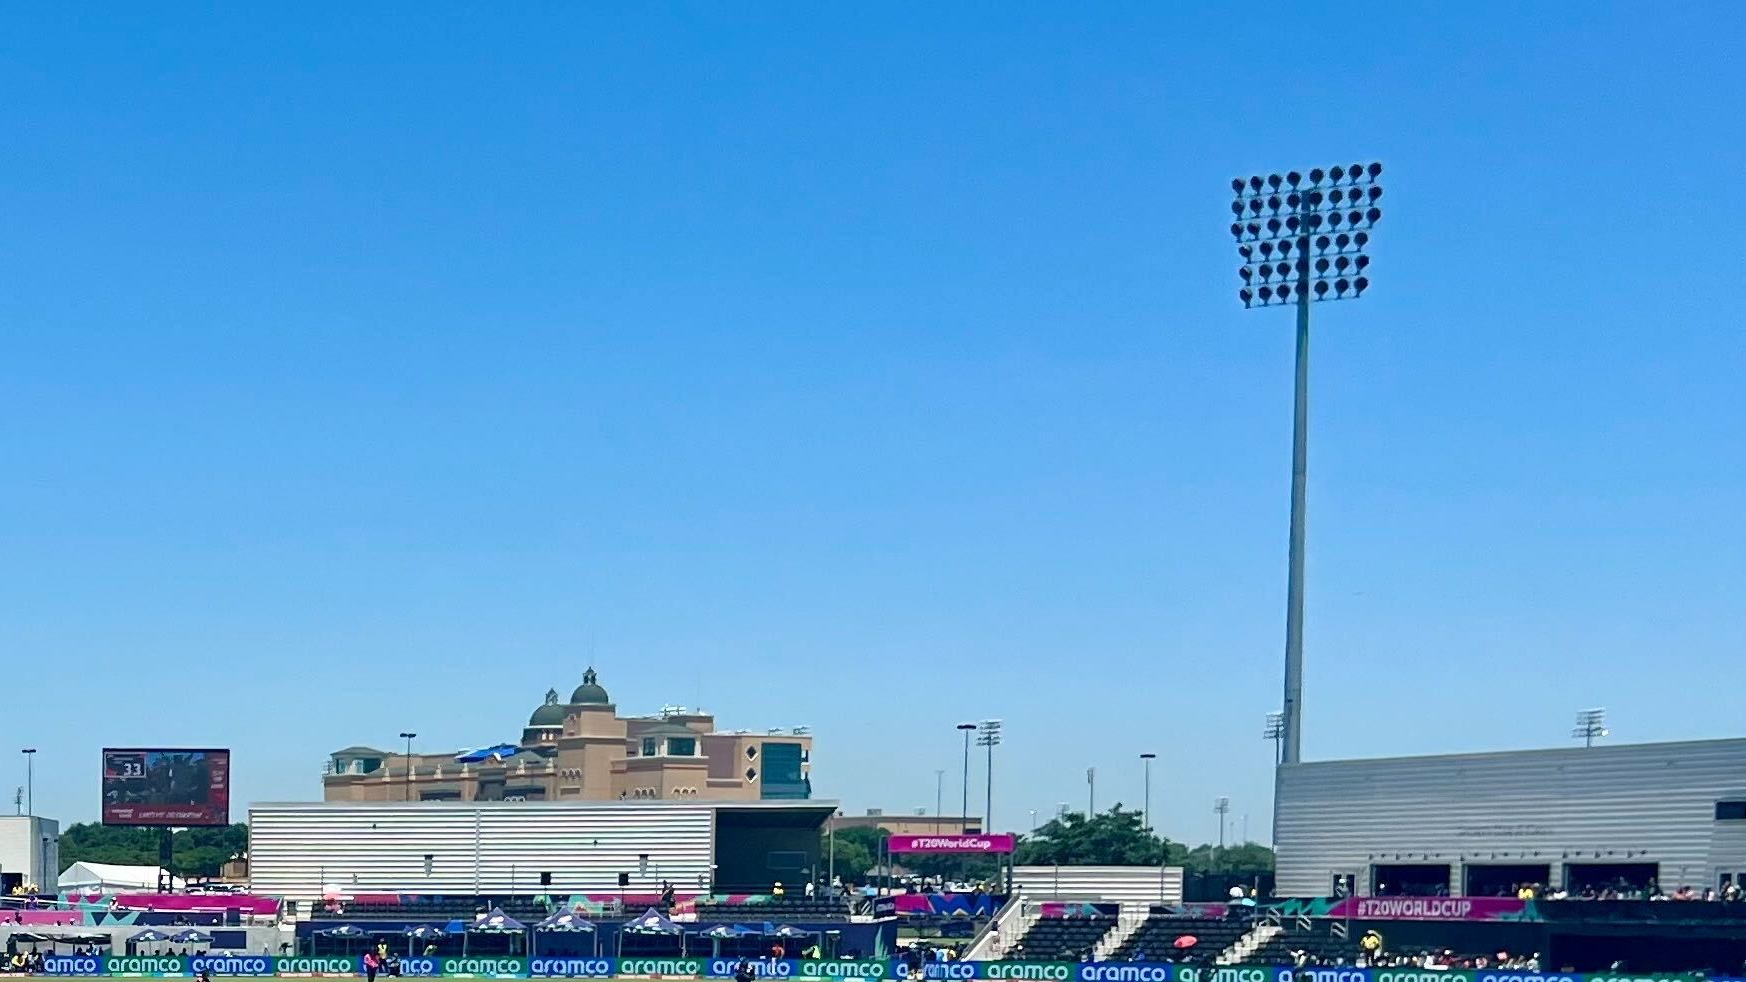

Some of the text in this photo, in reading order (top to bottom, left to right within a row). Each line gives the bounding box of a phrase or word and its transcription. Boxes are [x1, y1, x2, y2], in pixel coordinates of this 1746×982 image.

[124, 763, 142, 776] 33
[911, 839, 991, 851] #T20WorldCup
[1358, 901, 1471, 916] #T20WORLDCUP
[107, 959, 182, 973] aramco
[192, 958, 266, 973] aramco
[277, 959, 352, 973] aramco
[444, 959, 521, 974] aramco
[531, 960, 609, 975] aramco
[621, 961, 700, 975] aramco
[712, 961, 791, 976] armco
[803, 962, 884, 977] aramco
[987, 963, 1069, 979] aramco
[1081, 964, 1166, 982] aramco
